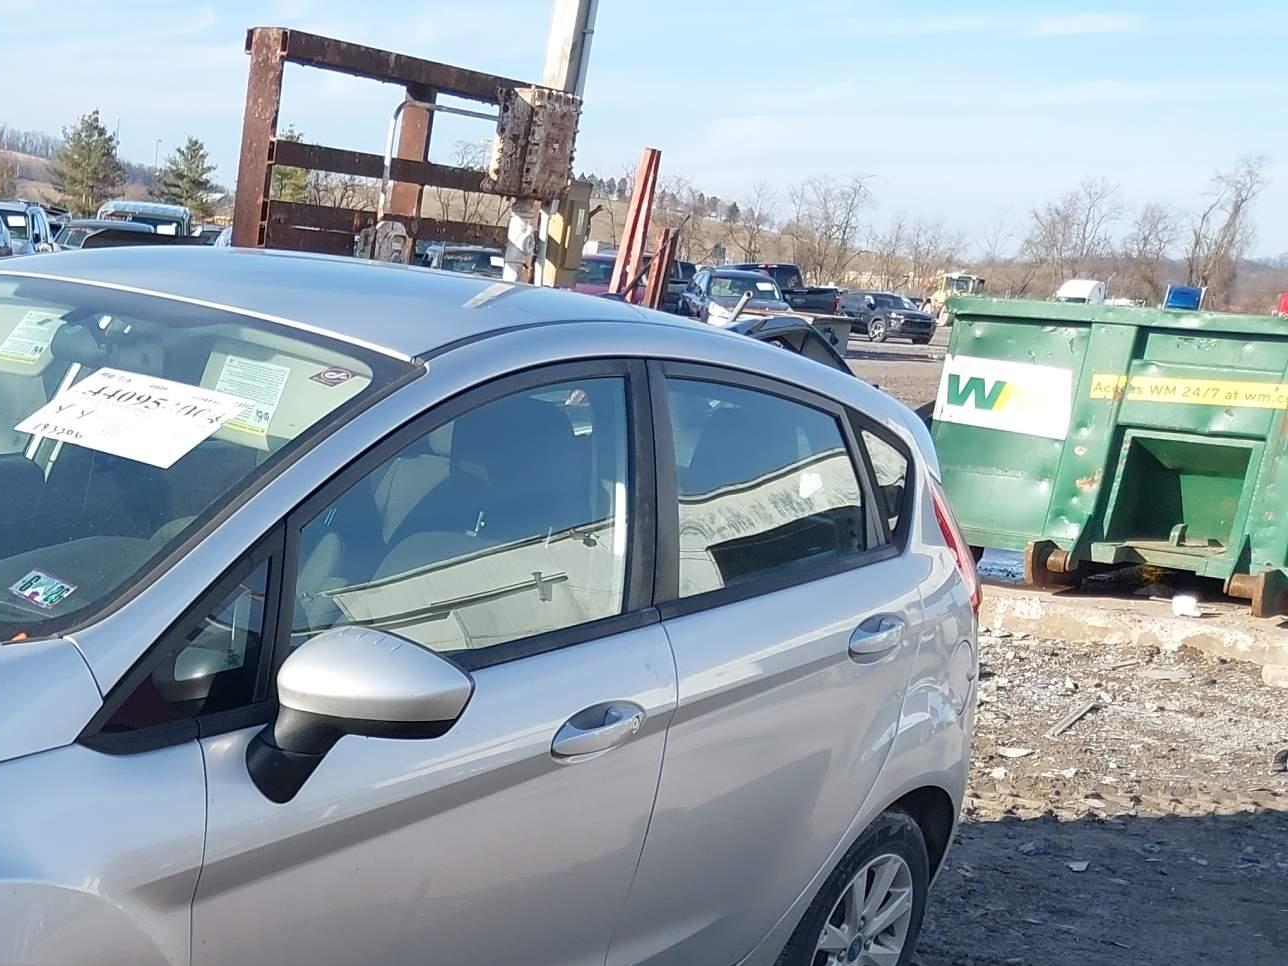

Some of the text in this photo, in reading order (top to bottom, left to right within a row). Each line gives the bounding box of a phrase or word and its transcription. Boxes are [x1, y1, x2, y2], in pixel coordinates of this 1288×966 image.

[1149, 384, 1178, 398] WM
[1182, 386, 1220, 399] 24/7
[1224, 389, 1239, 401] at
